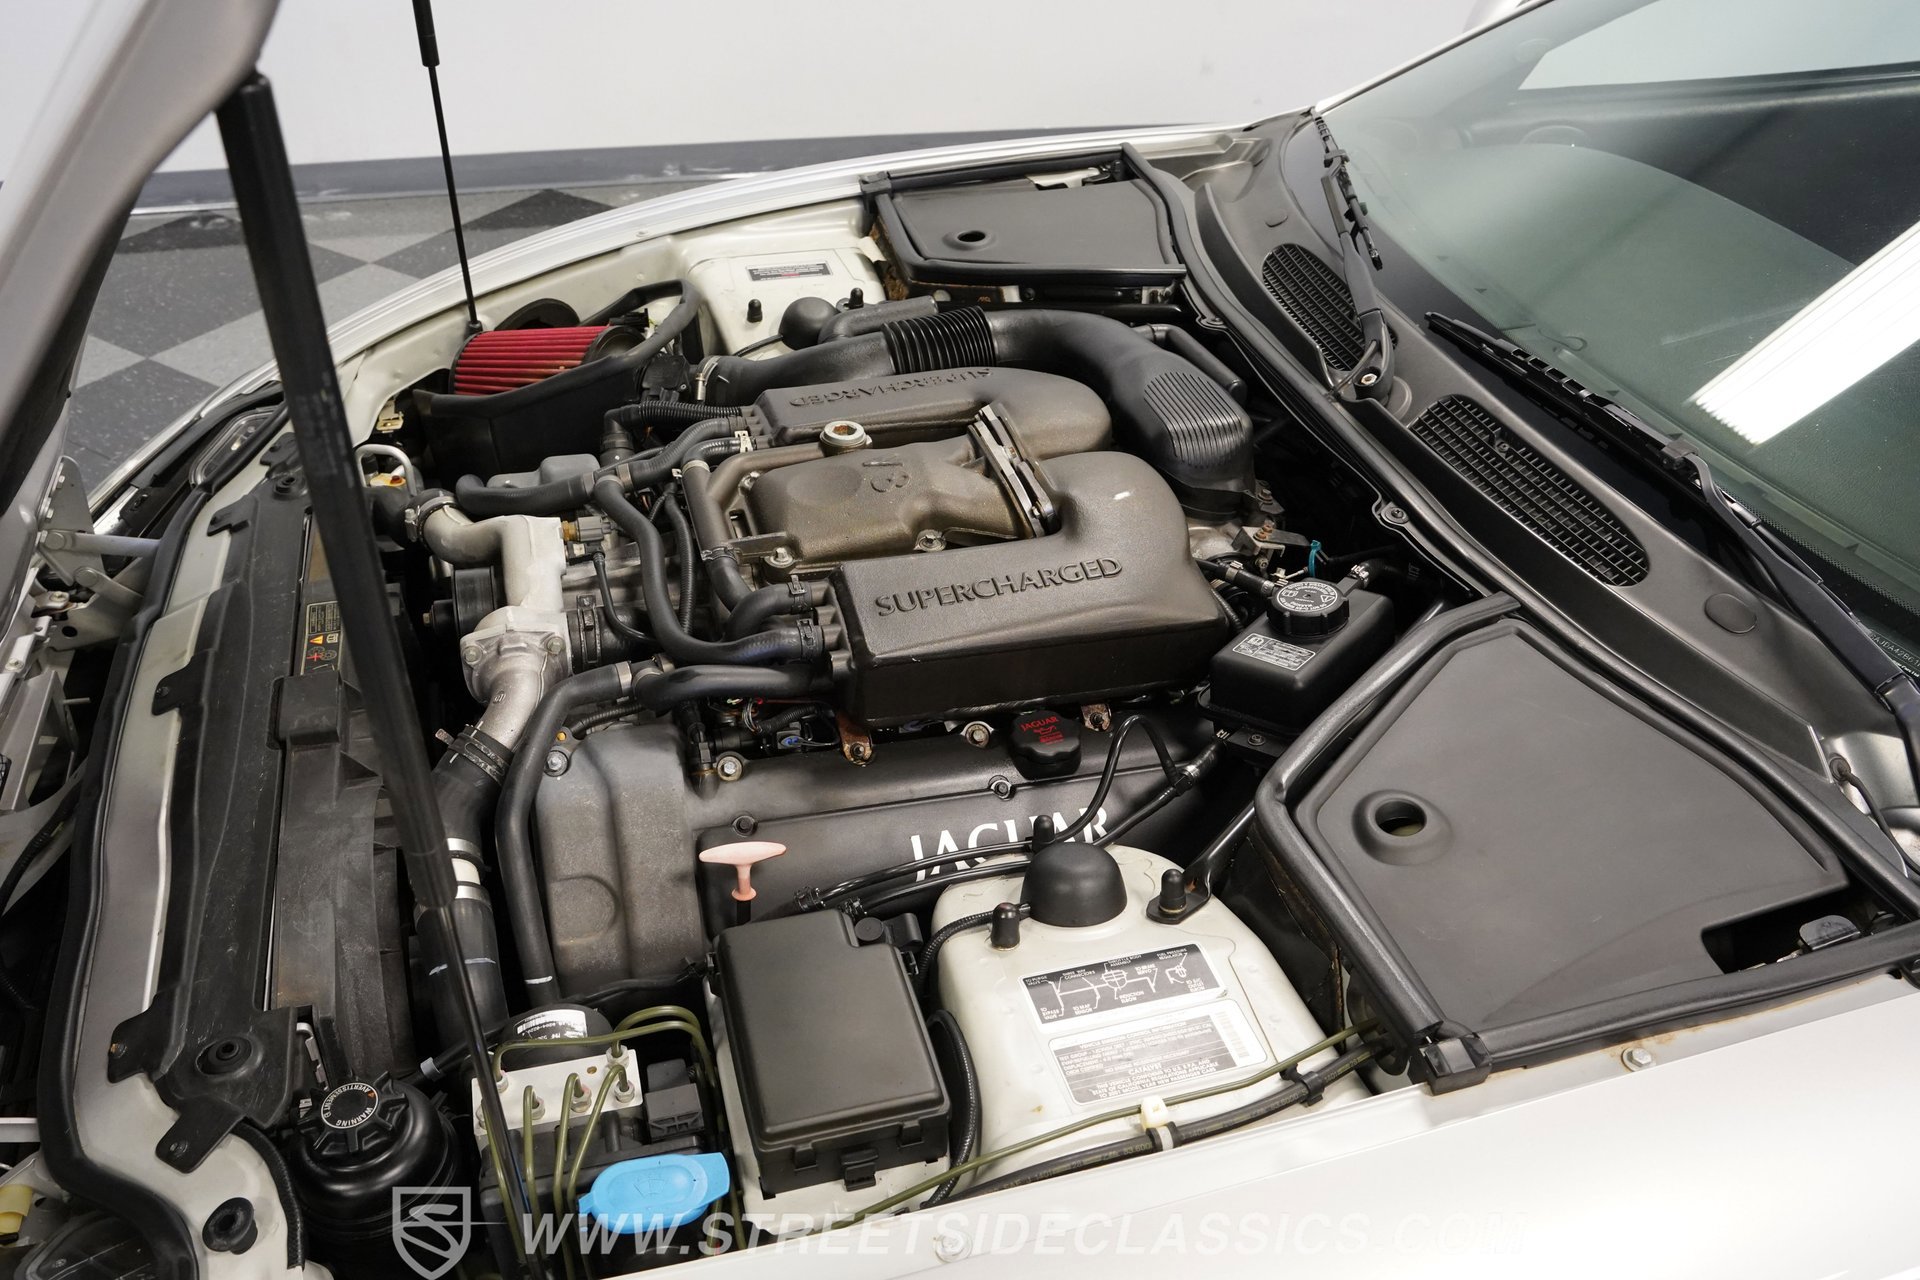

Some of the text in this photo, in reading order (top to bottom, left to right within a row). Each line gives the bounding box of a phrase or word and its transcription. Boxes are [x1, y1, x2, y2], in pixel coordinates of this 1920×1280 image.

[788, 368, 993, 407] SUPERCHARGED
[875, 557, 1122, 616] SUPERCHARGED
[1020, 716, 1059, 732] JAGUAR
[323, 1084, 371, 1111] AVERTISSEMENT
[336, 1107, 374, 1127] WARNING
